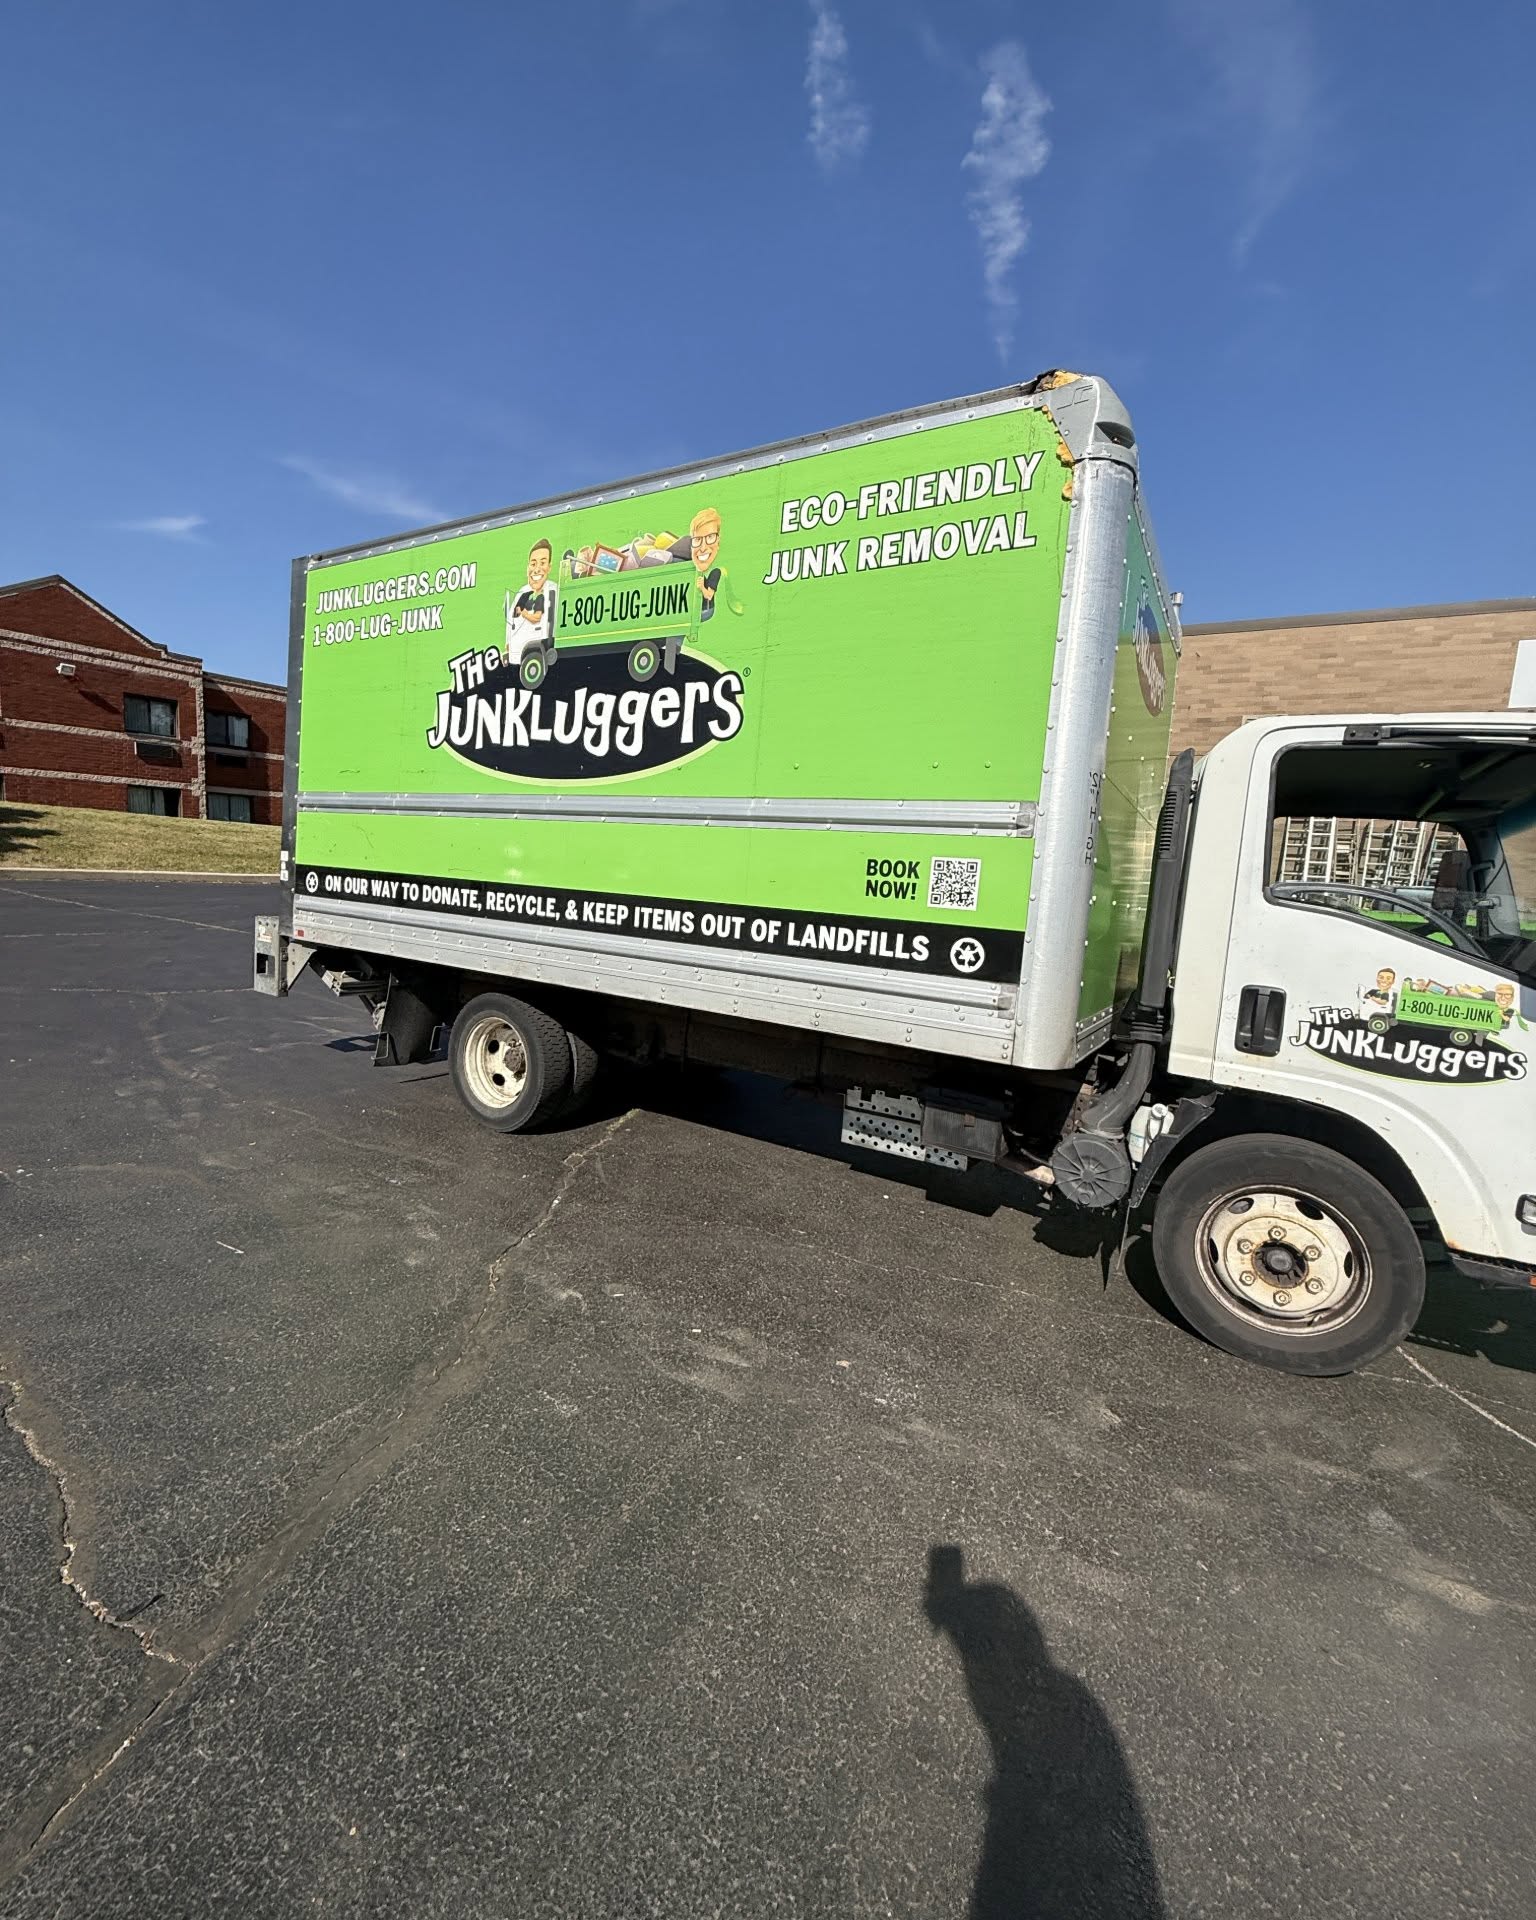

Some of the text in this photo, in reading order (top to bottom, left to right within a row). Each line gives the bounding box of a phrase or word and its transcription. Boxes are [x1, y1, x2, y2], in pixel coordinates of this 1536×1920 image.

[781, 450, 1046, 534] ECO-FRIENDLY
[762, 511, 1037, 585] JUNK REMOVAL
[315, 562, 477, 614] JUNKLUGGERS.COM
[560, 582, 690, 628] 1-800-LUG-JUNK
[313, 604, 444, 647] 1-800-LUG-JUNK
[865, 879, 917, 900] NOW!
[866, 858, 920, 879] BOOK
[325, 875, 930, 961] ON OUR WAY TO DONATE, RECYCLE, & KEEP ITEMS OUT OF LANDFILLS
[1400, 999, 1494, 1023] 1-800-LUG-JUNK
